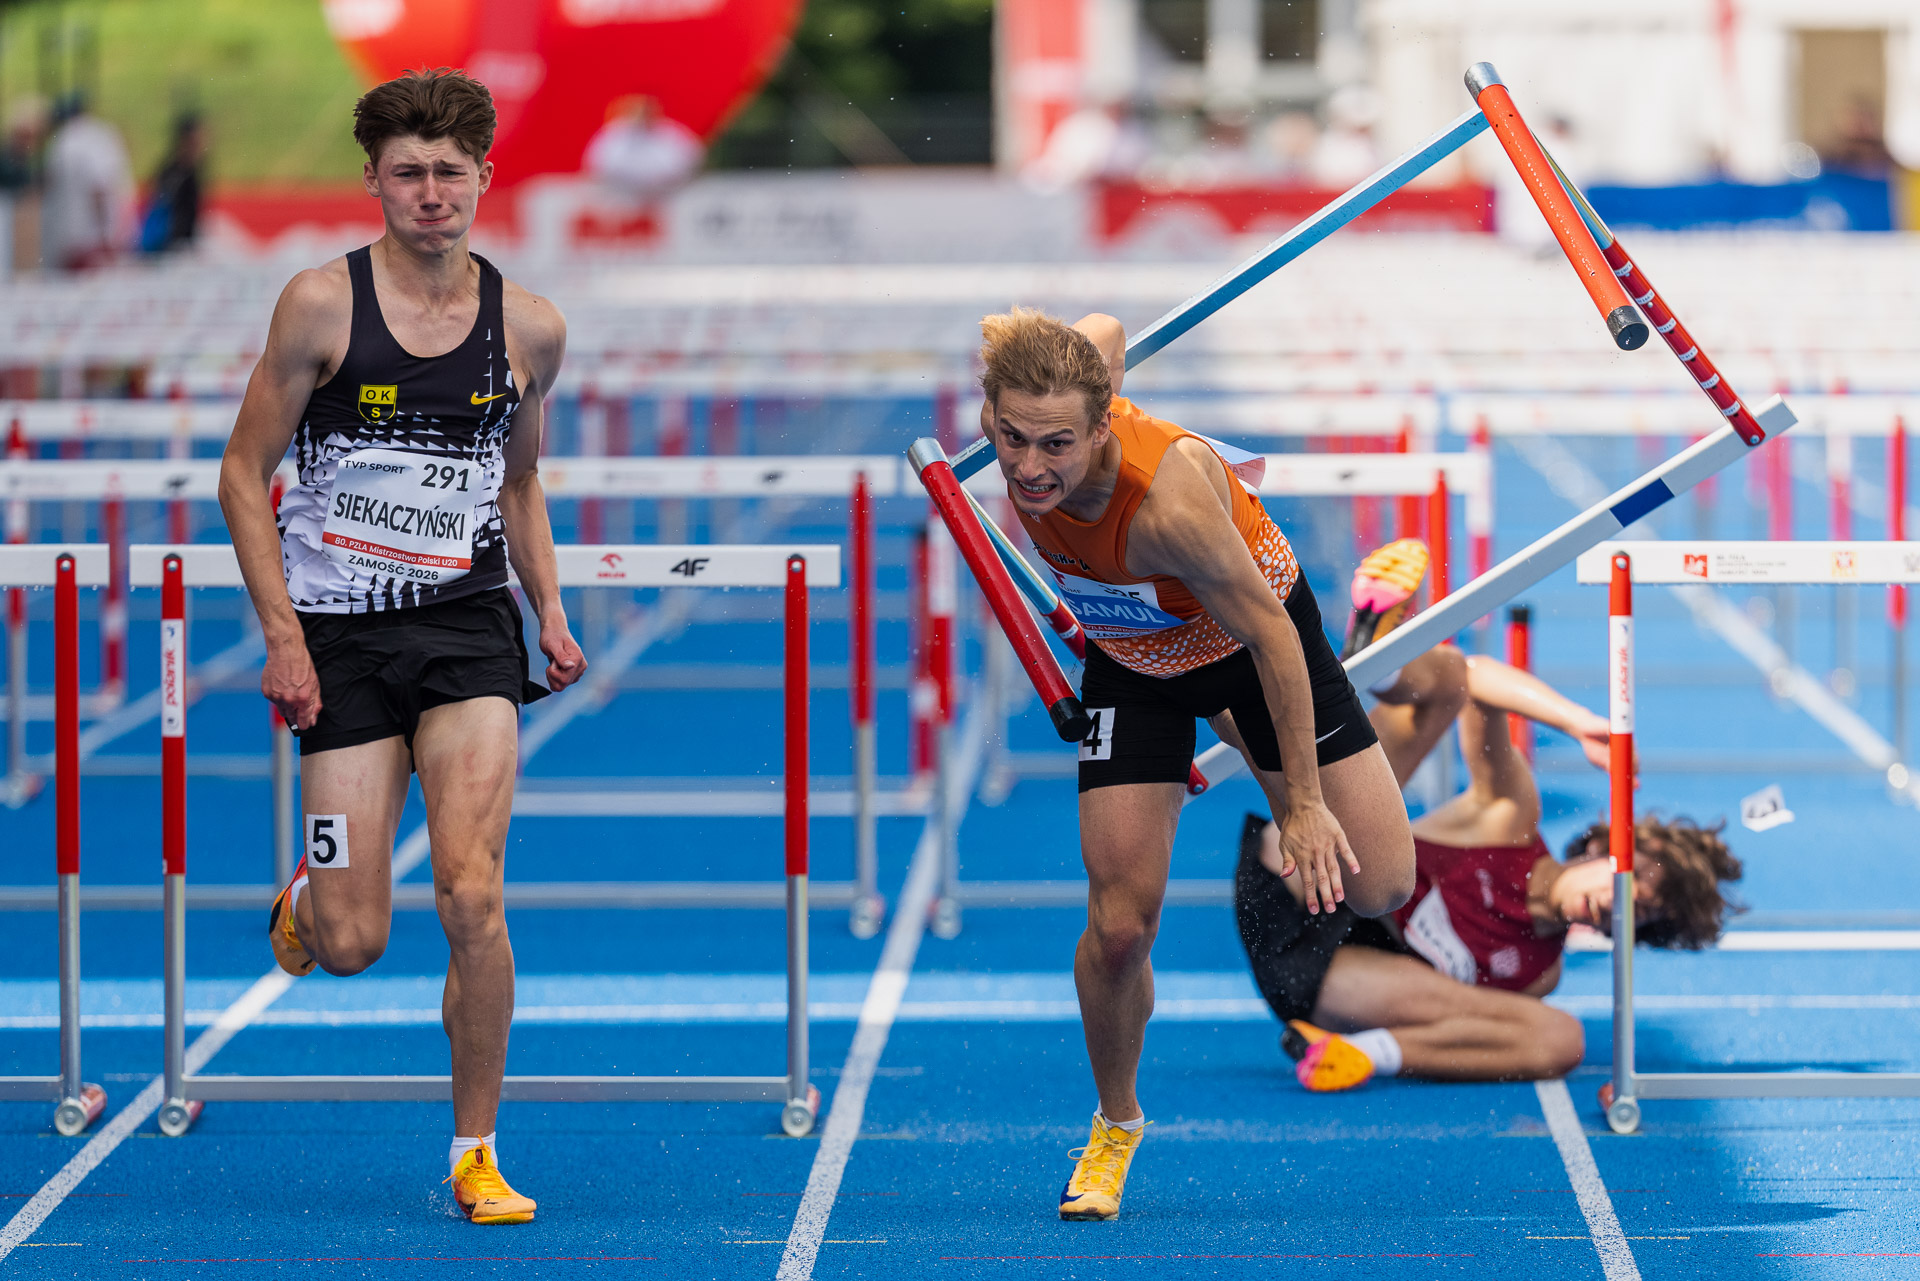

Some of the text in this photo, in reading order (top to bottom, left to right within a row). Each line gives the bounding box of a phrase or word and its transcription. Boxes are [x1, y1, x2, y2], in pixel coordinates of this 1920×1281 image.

[371, 407, 381, 418] S
[344, 459, 406, 474] TVP SPORT
[420, 463, 469, 492] 291
[333, 492, 465, 541] SIEKACZYŃSKI
[334, 536, 458, 567] 80. PZLA Mistrzostwa Polski U20
[348, 554, 439, 580] ZAMOŚĆ 2026
[670, 557, 711, 577] 4F
[1065, 596, 1166, 624] SAMUL
[1082, 711, 1103, 756] 4
[312, 819, 337, 865] 5
